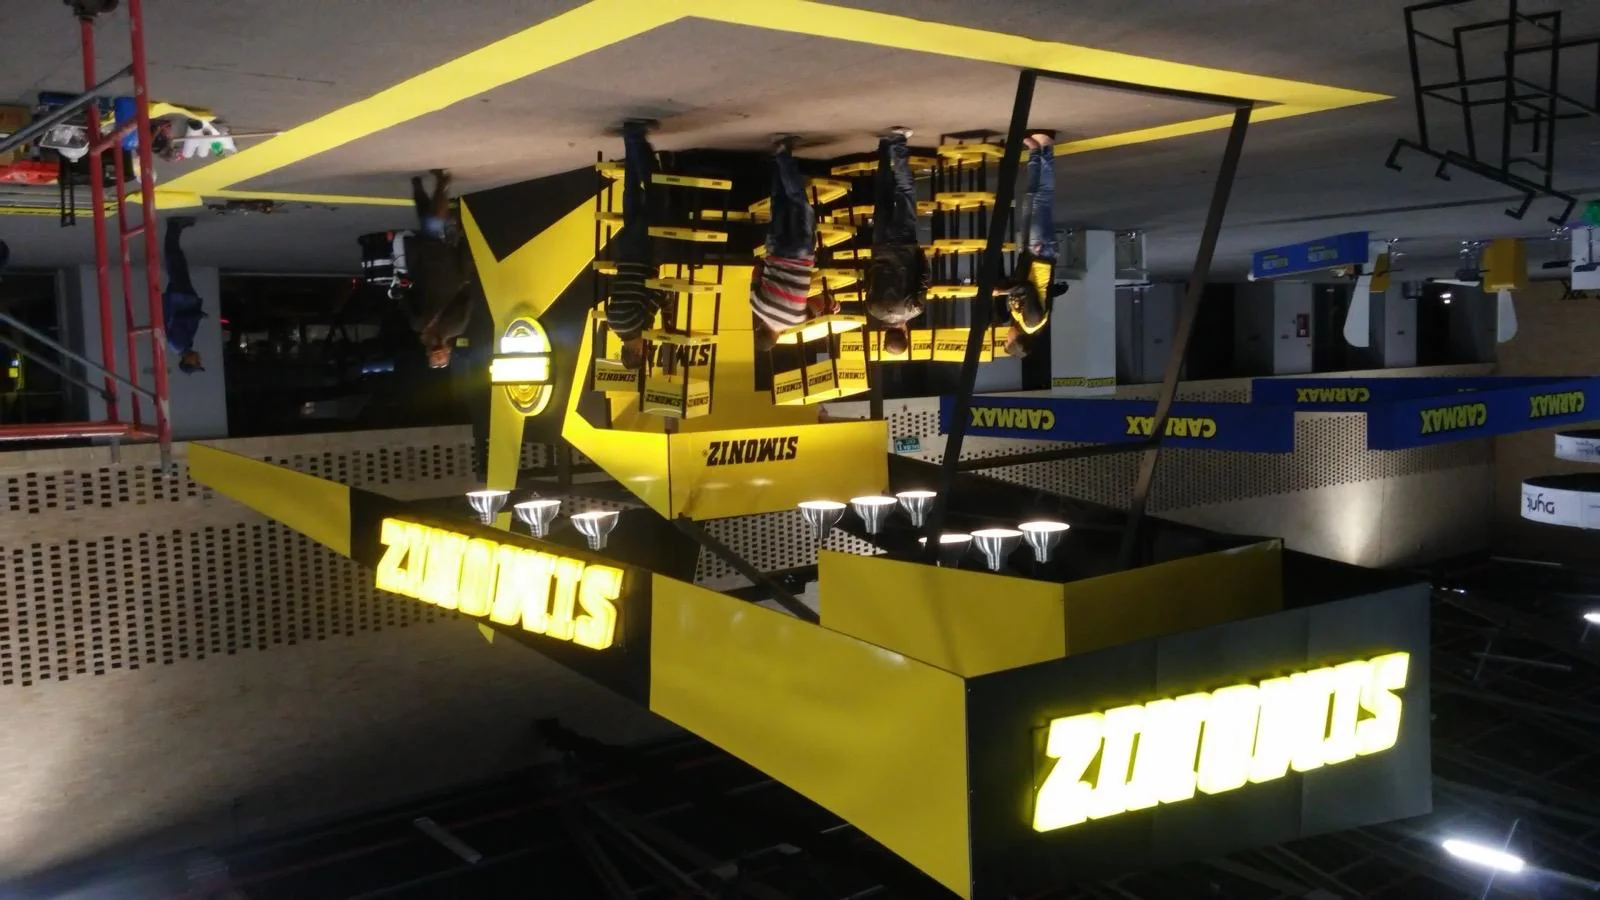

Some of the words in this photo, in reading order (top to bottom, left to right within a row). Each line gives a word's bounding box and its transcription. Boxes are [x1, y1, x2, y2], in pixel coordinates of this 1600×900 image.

[598, 373, 636, 382] SIMONIZ
[776, 382, 802, 395] SIMONIZ
[839, 372, 865, 380] SIMONIZ
[1296, 387, 1370, 402] CARMAX
[1529, 391, 1584, 418] CARMAX
[970, 406, 1056, 430] CARMAX
[1420, 403, 1487, 434] CARMAX
[706, 436, 798, 466] SIMONIZ
[375, 517, 624, 650] SIMONIZ
[1032, 652, 1409, 833] SIMONIZ
